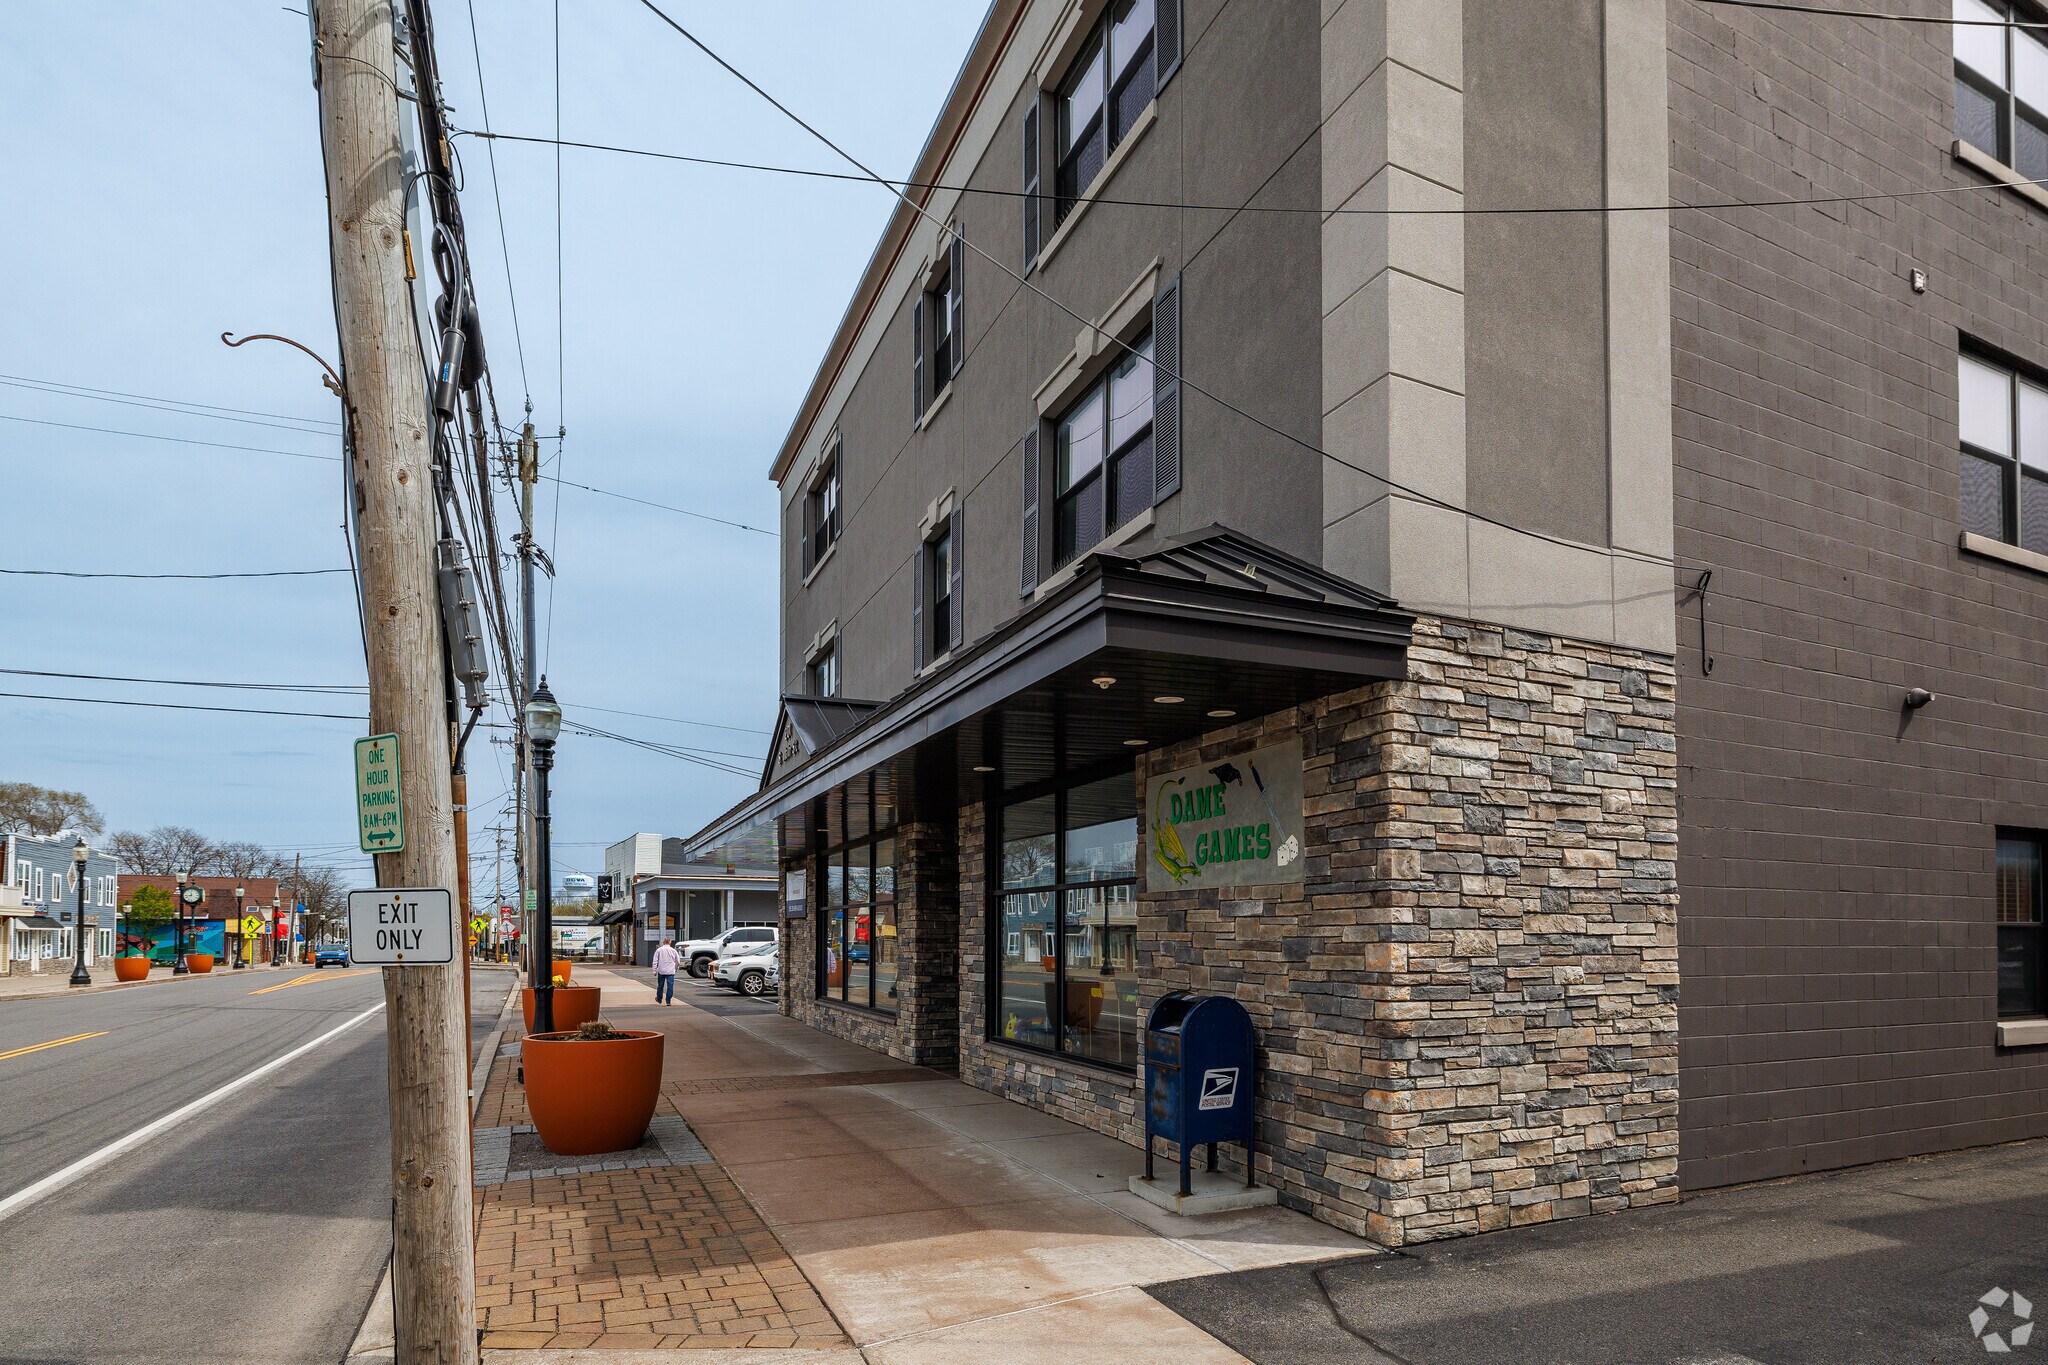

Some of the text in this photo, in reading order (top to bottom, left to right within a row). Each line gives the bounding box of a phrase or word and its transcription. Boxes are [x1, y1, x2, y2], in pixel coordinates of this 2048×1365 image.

[368, 748, 385, 764] ONE
[366, 769, 389, 786] HOUR
[362, 790, 396, 807] PARKING
[1170, 783, 1227, 825] DAME
[1195, 822, 1271, 866] GAMES
[379, 903, 418, 924] EXIT
[376, 929, 423, 951] ONLY
